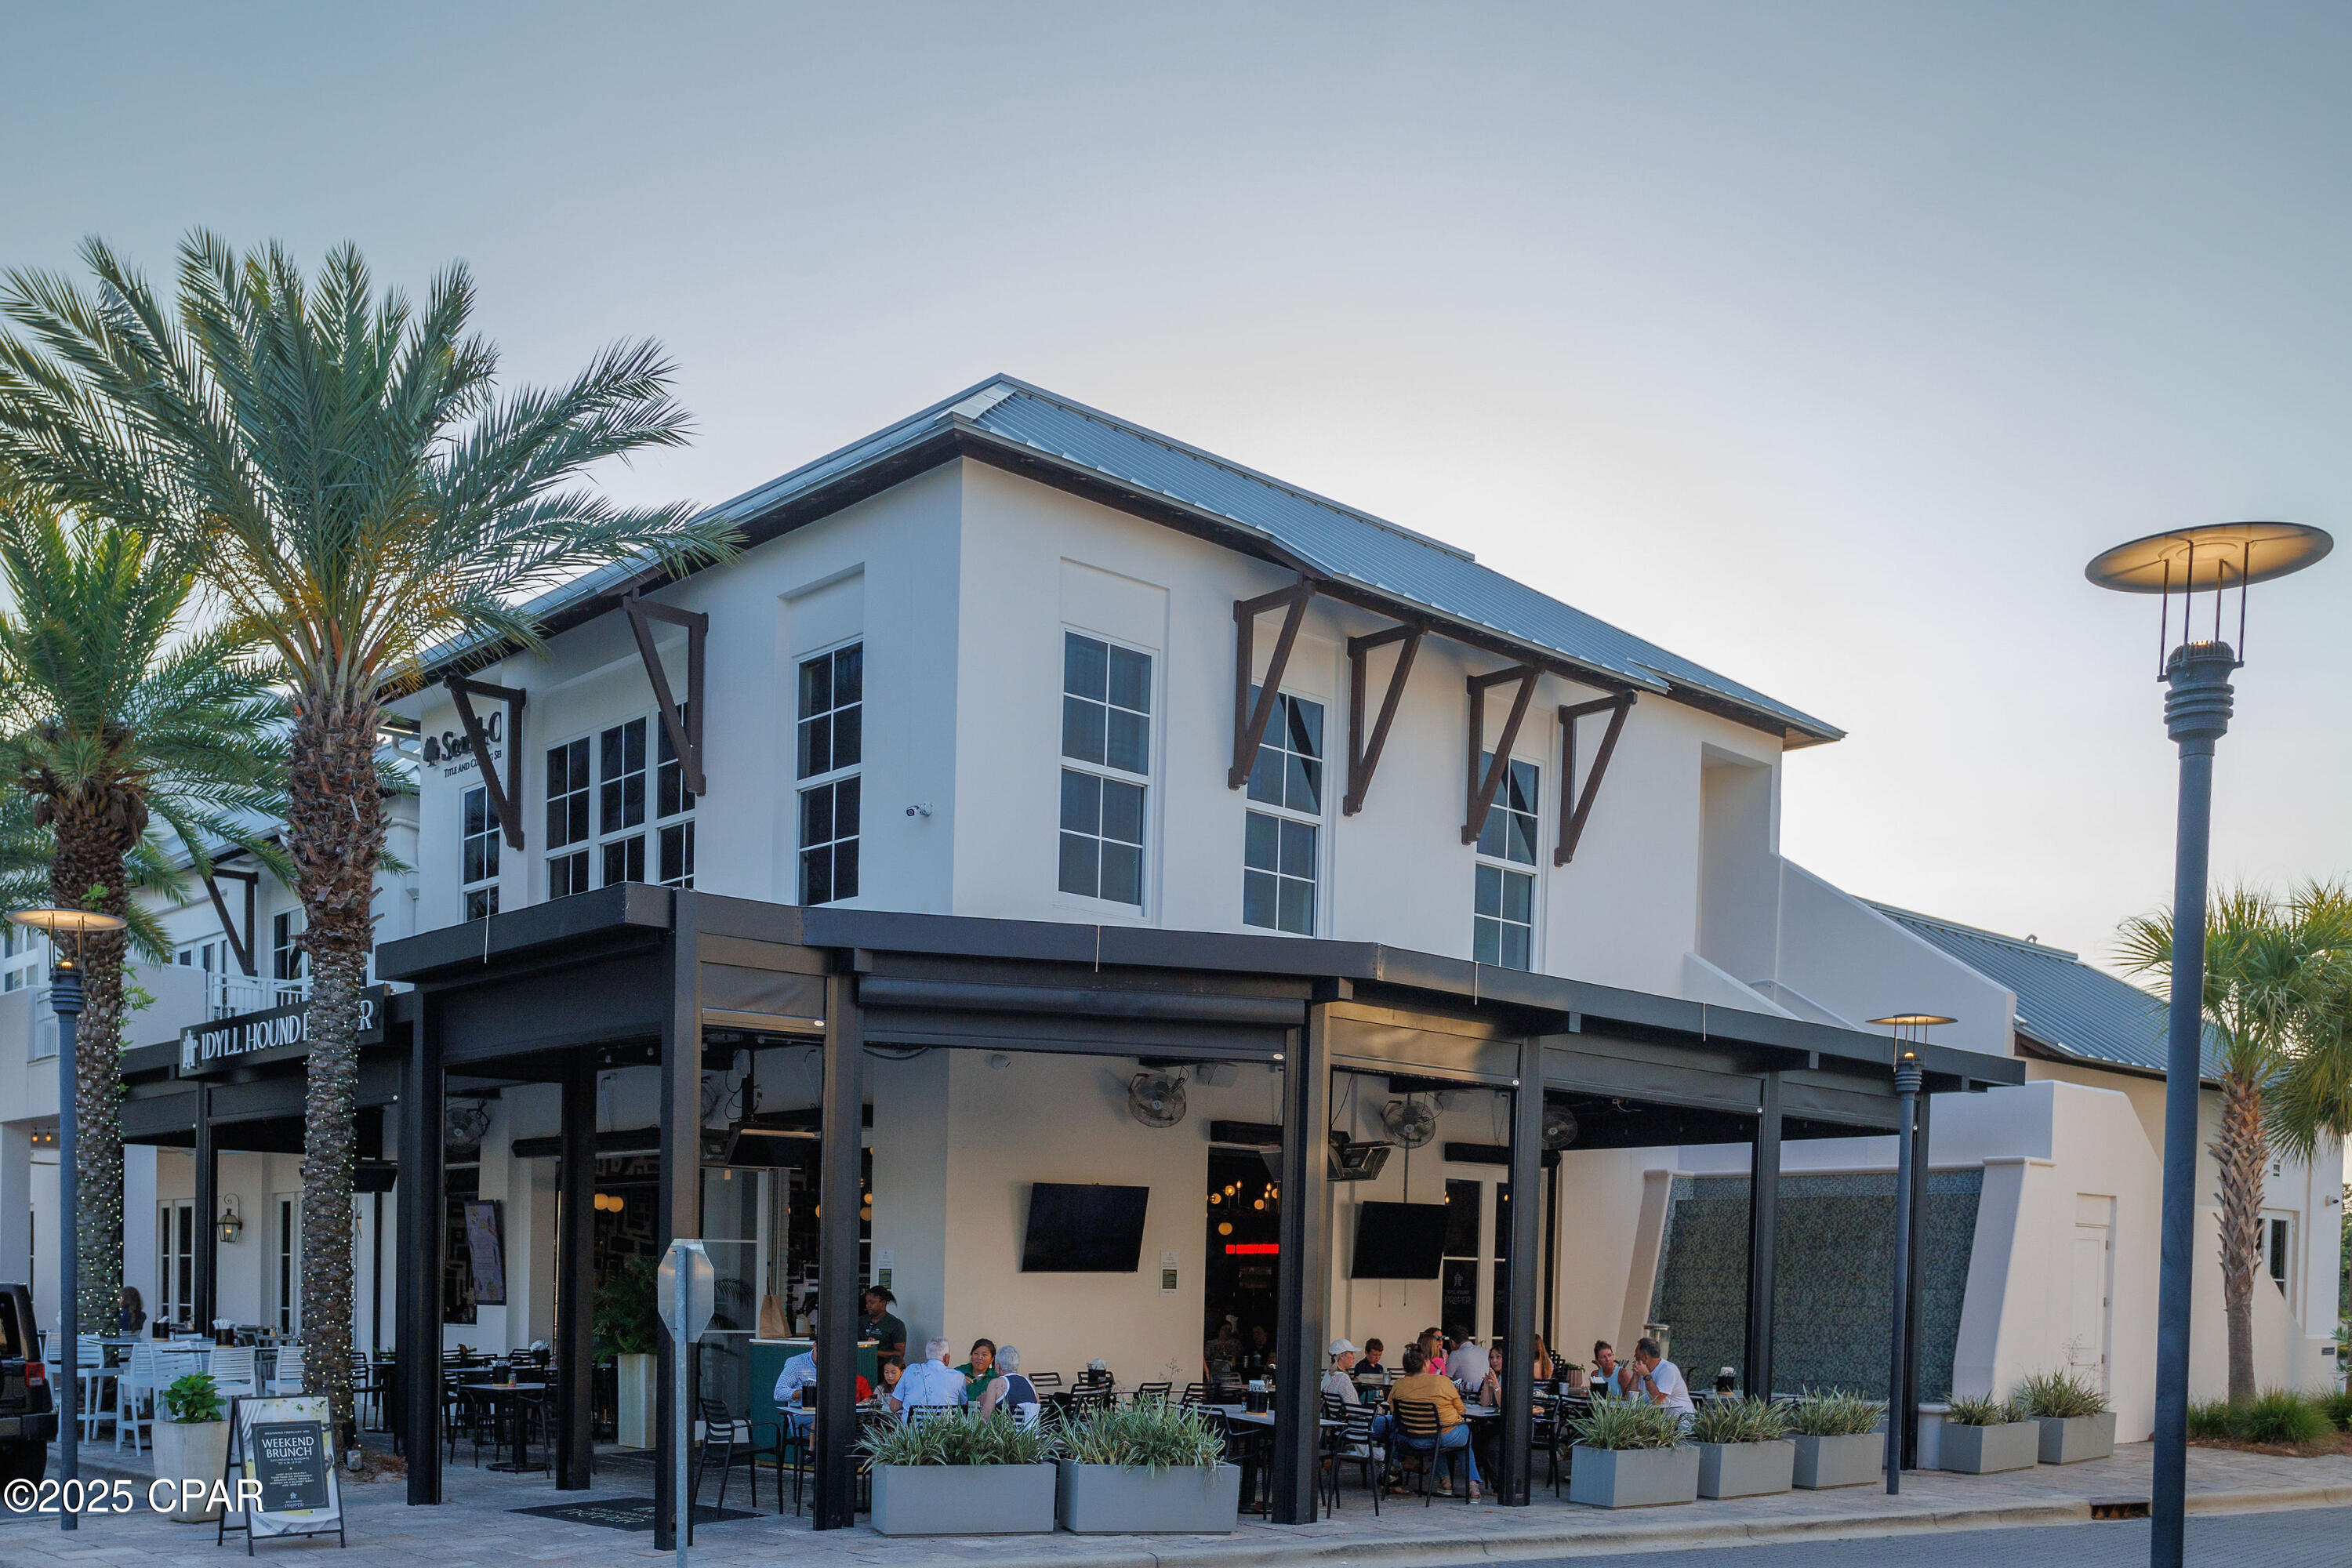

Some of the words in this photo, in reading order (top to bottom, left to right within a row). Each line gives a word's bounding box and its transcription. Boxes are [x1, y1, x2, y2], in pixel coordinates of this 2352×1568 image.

[201, 1027, 243, 1060] IDYLL
[245, 1014, 301, 1052] HOUND
[262, 1436, 314, 1448] WEEKEND
[267, 1446, 312, 1458] BRUNCH
